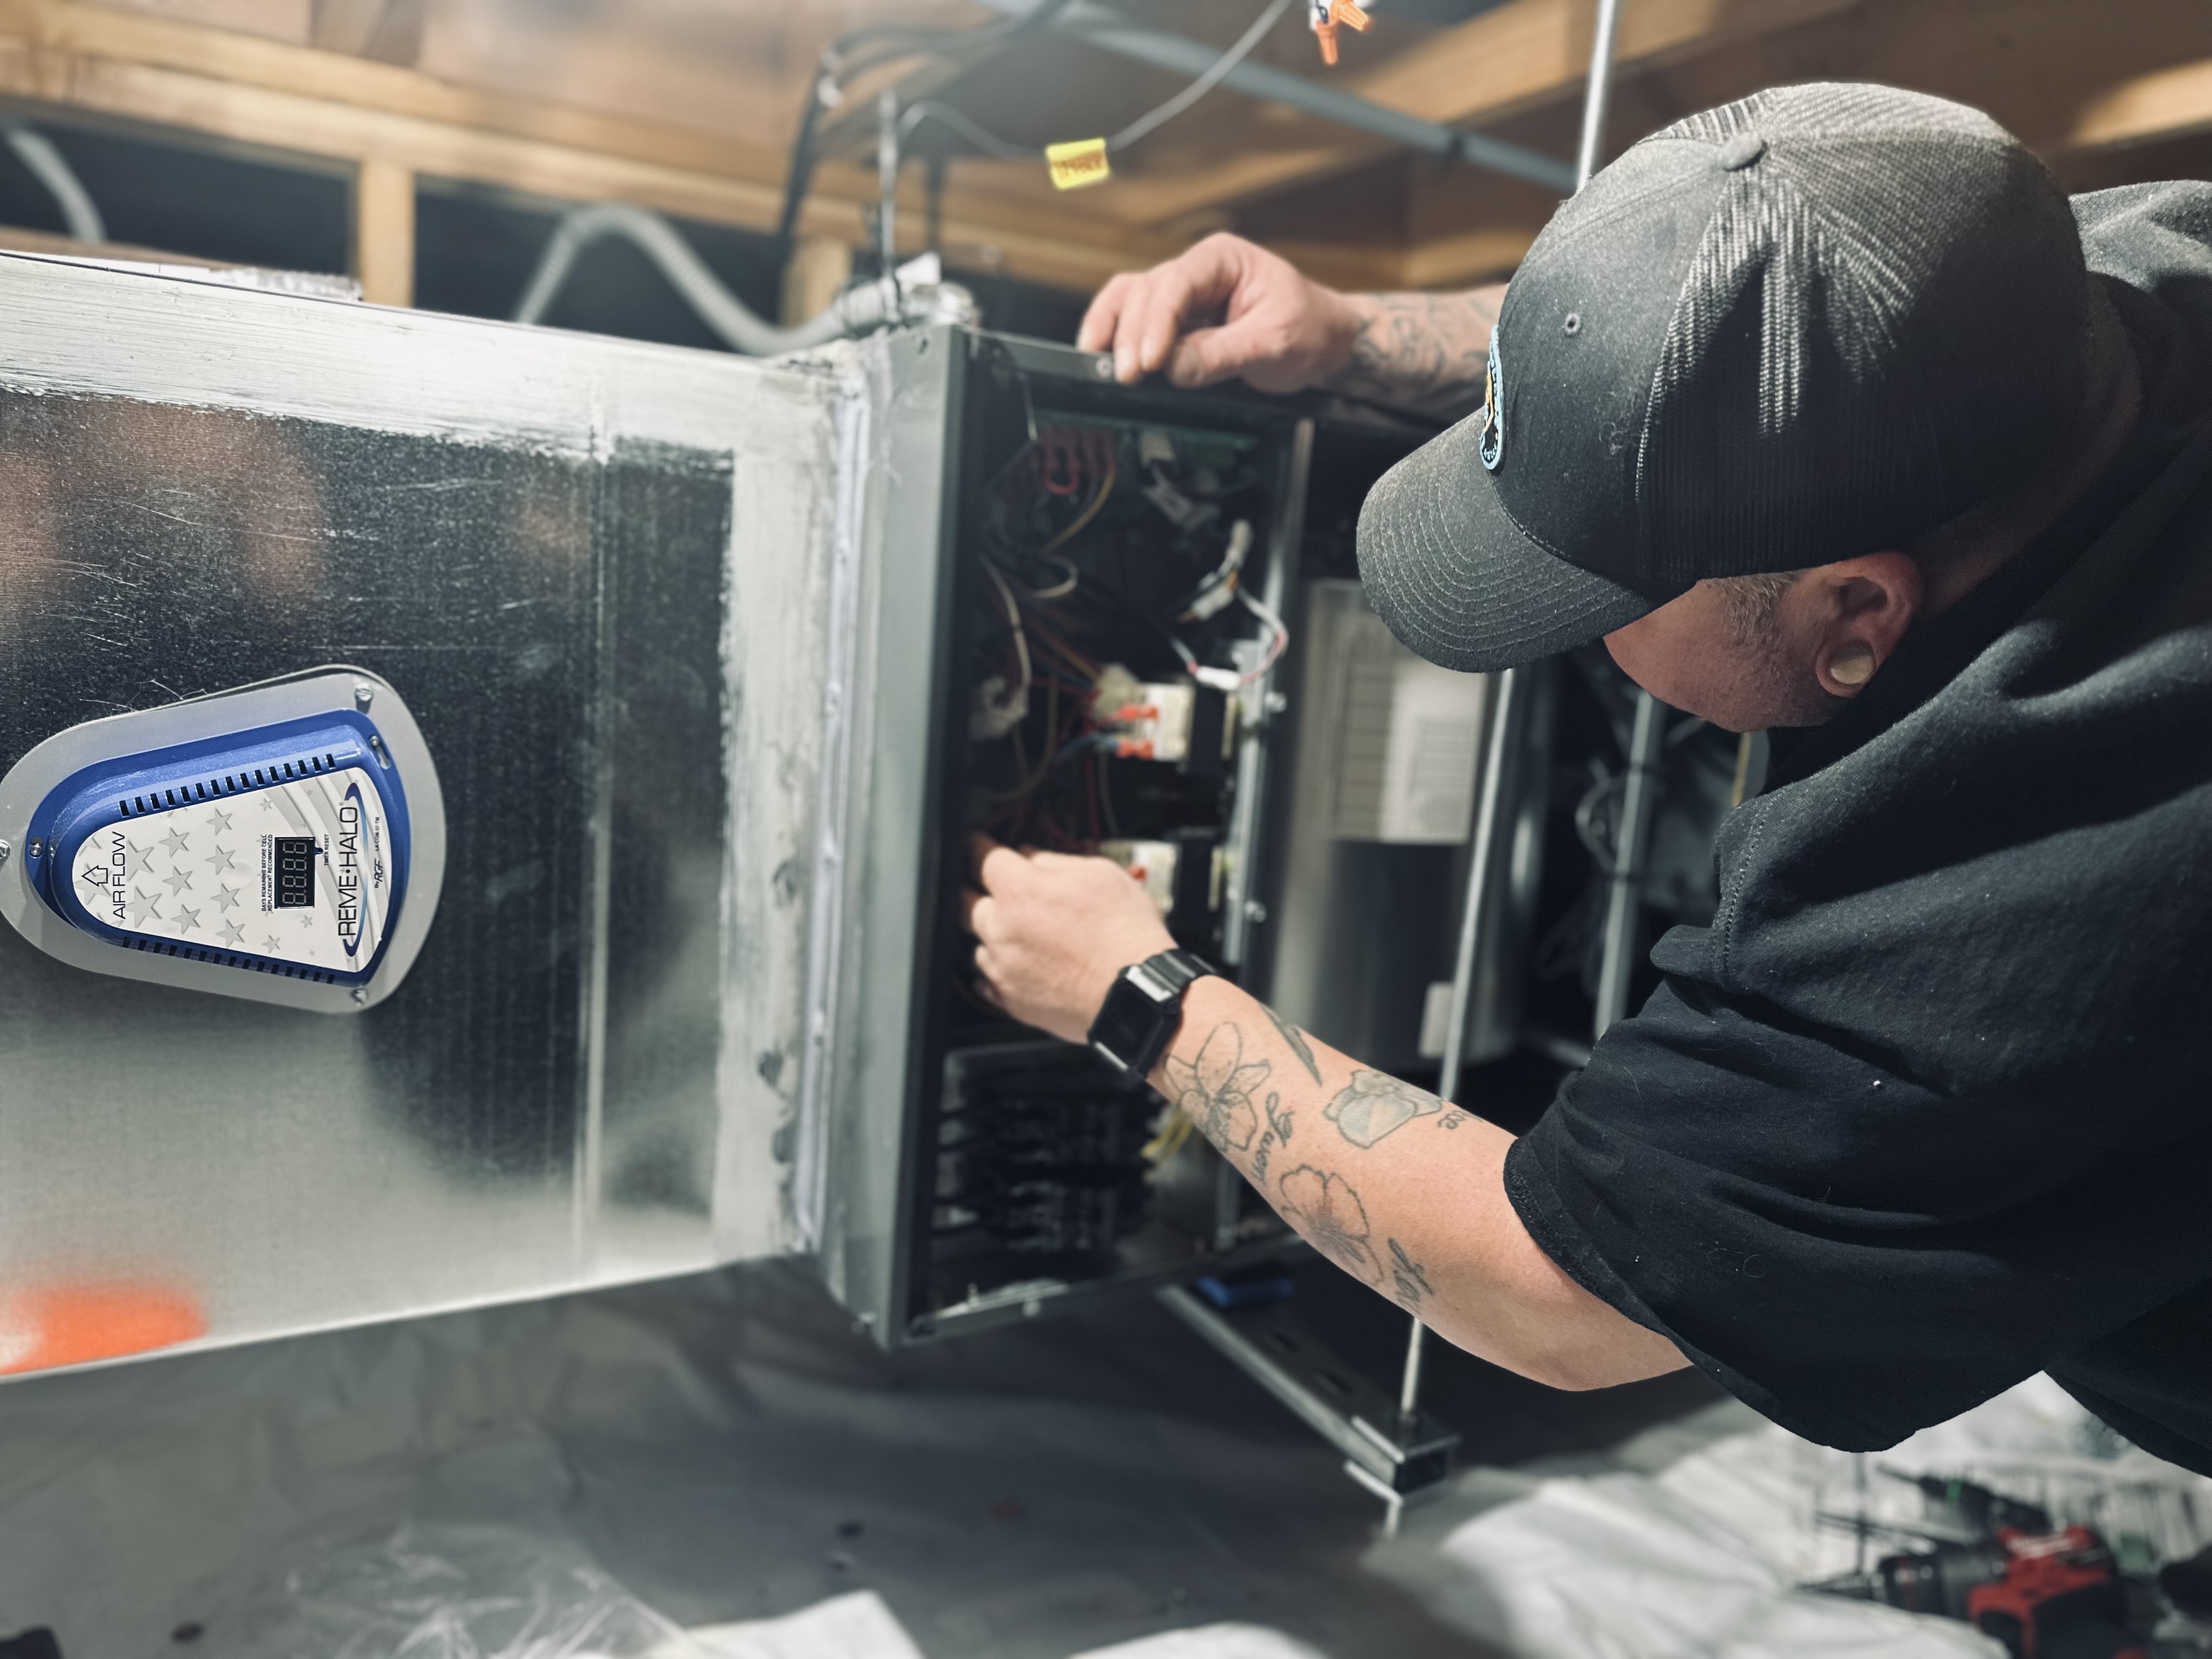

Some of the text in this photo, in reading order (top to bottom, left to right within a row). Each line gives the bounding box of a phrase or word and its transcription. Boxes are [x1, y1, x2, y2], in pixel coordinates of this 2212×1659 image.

[112, 831, 126, 919] AIR FLOW
[374, 859, 383, 882] RGF
